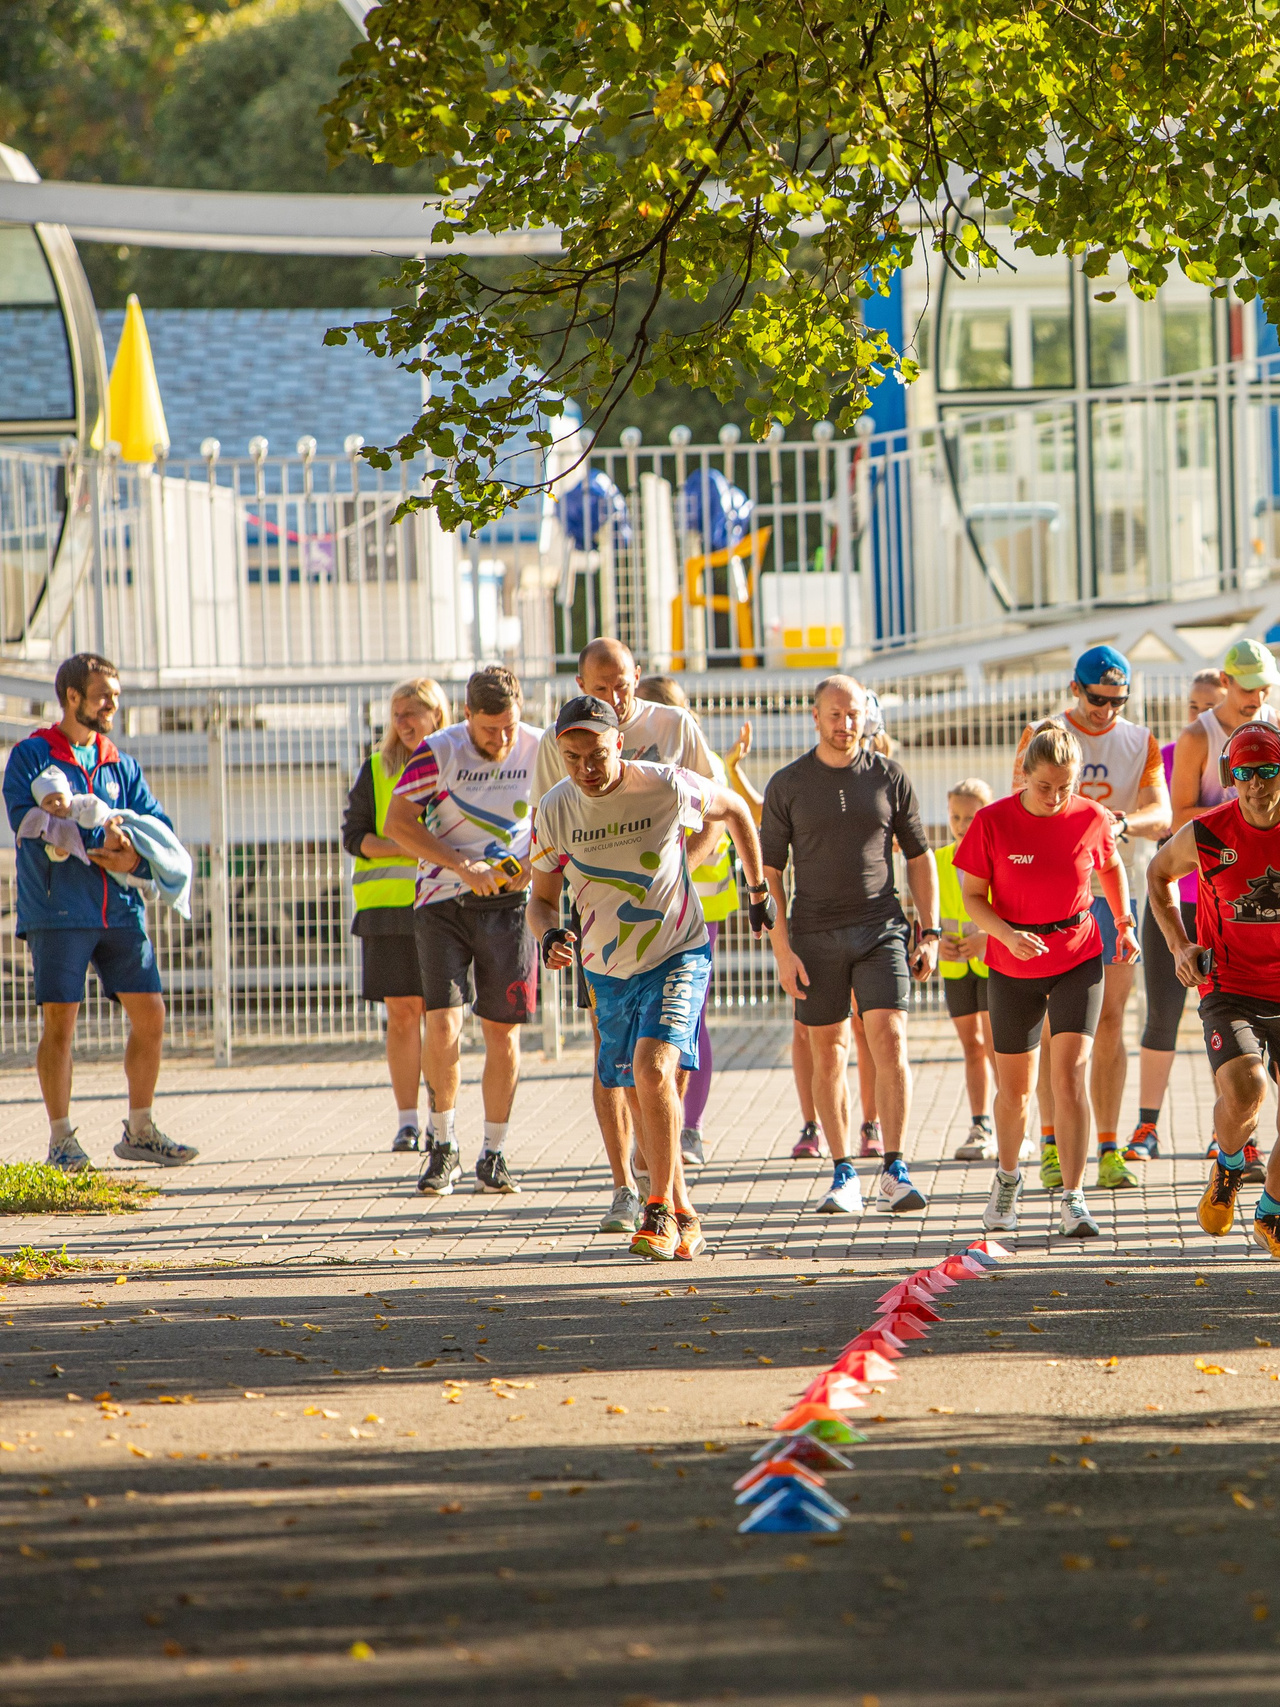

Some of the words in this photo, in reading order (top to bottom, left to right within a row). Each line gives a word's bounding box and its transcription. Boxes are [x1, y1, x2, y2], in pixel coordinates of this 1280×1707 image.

[583, 845, 597, 854] RUN
[597, 842, 614, 851] CLUB
[613, 836, 643, 848] IVANOVO
